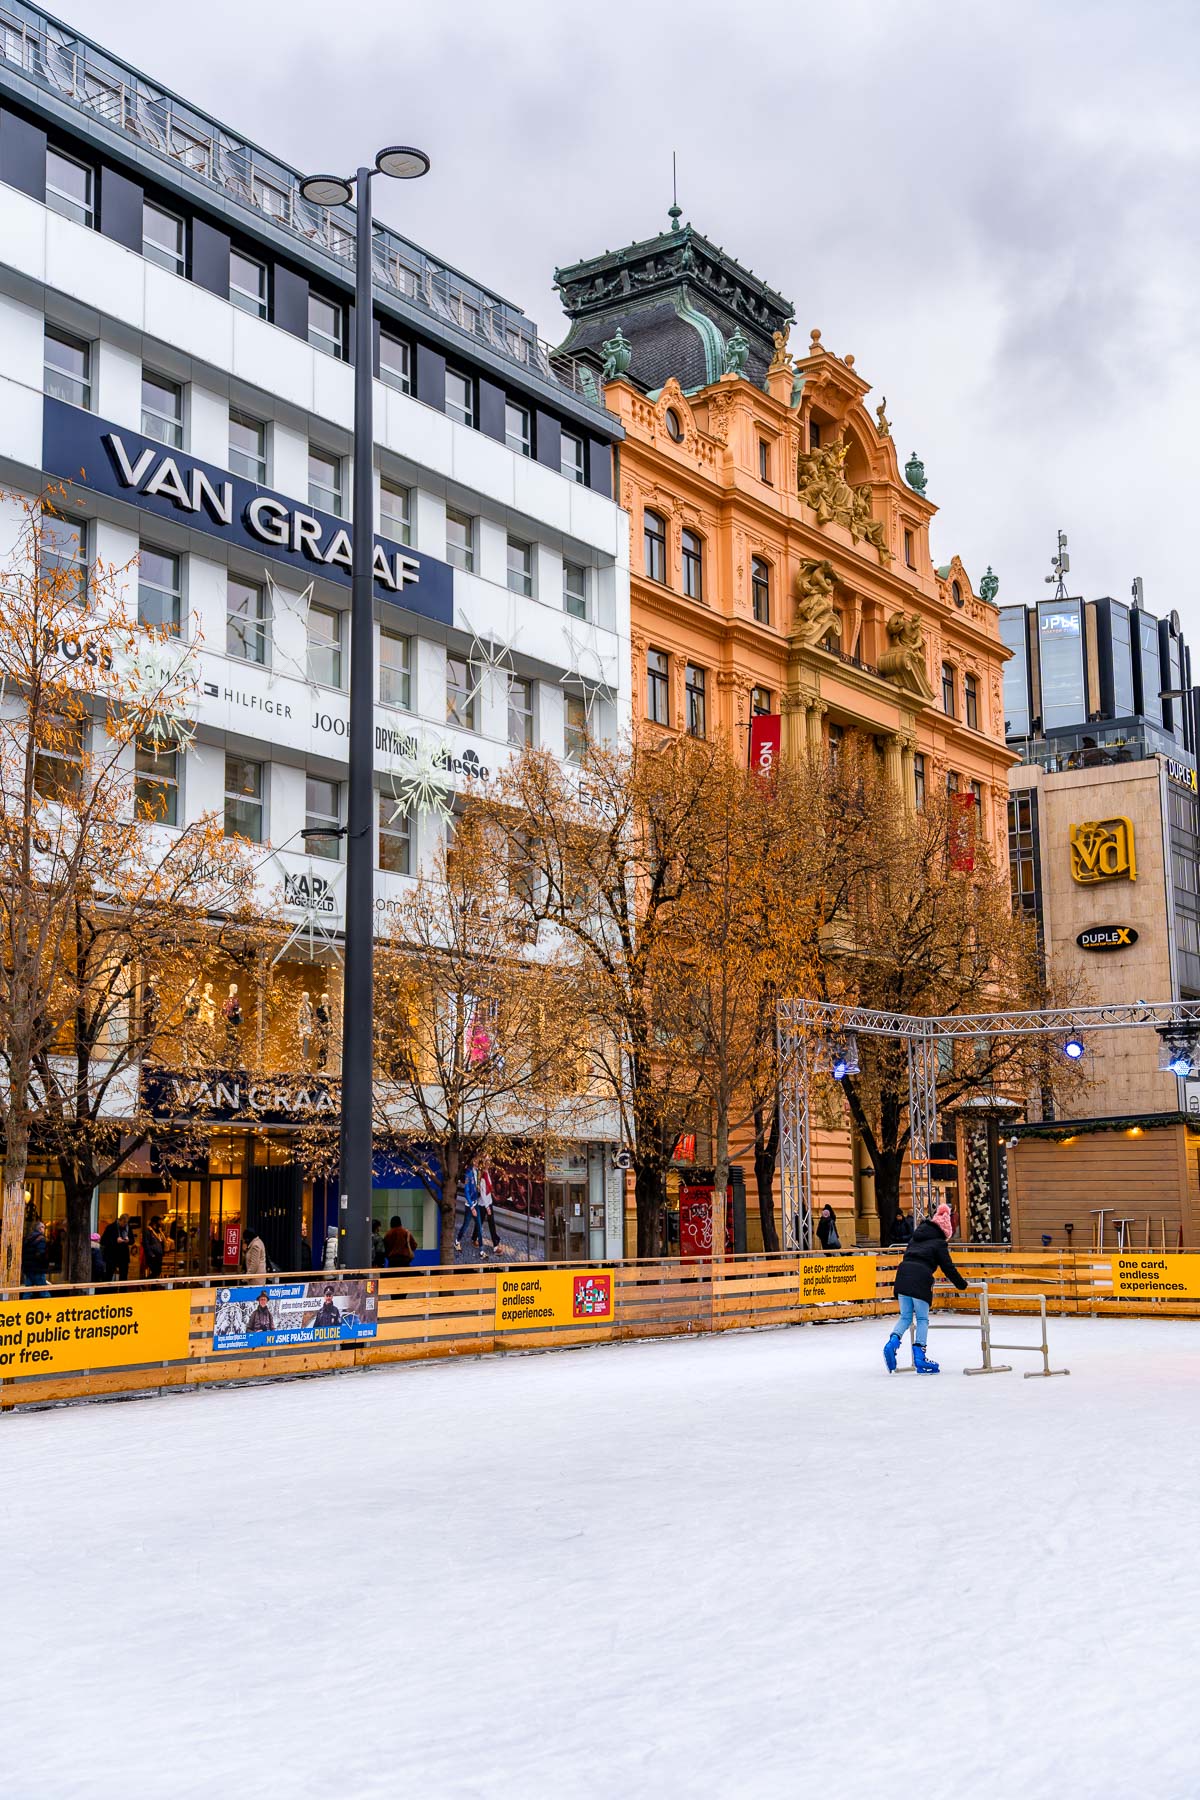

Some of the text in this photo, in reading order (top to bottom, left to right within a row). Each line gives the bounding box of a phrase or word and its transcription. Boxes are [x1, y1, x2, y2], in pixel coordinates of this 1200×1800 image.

[101, 433, 421, 592] VAN GRAAF
[225, 688, 292, 719] HILFIGER
[758, 741, 773, 779] AON
[1168, 759, 1198, 794] DUPLEX
[284, 872, 334, 902] KARL
[1082, 928, 1131, 945] DUPLEX
[171, 1079, 240, 1109] VAN
[803, 1263, 855, 1274] Get 60+ attractions
[1118, 1259, 1168, 1271] One card,
[803, 1274, 857, 1286] and public transport
[1119, 1270, 1160, 1280] endless
[502, 1279, 542, 1292] One card,
[803, 1286, 826, 1296] for free.
[1120, 1281, 1188, 1292] experiences.
[502, 1294, 535, 1306] endless
[25, 1310, 52, 1327] 60+
[56, 1304, 134, 1323] attractions
[502, 1307, 555, 1322] experiences.
[26, 1327, 71, 1348] public
[74, 1321, 139, 1340] transport
[276, 1333, 290, 1344] JSME
[290, 1330, 314, 1342] PRAŽSKÁ
[314, 1327, 341, 1340] POLICIE
[20, 1347, 54, 1364] free.
